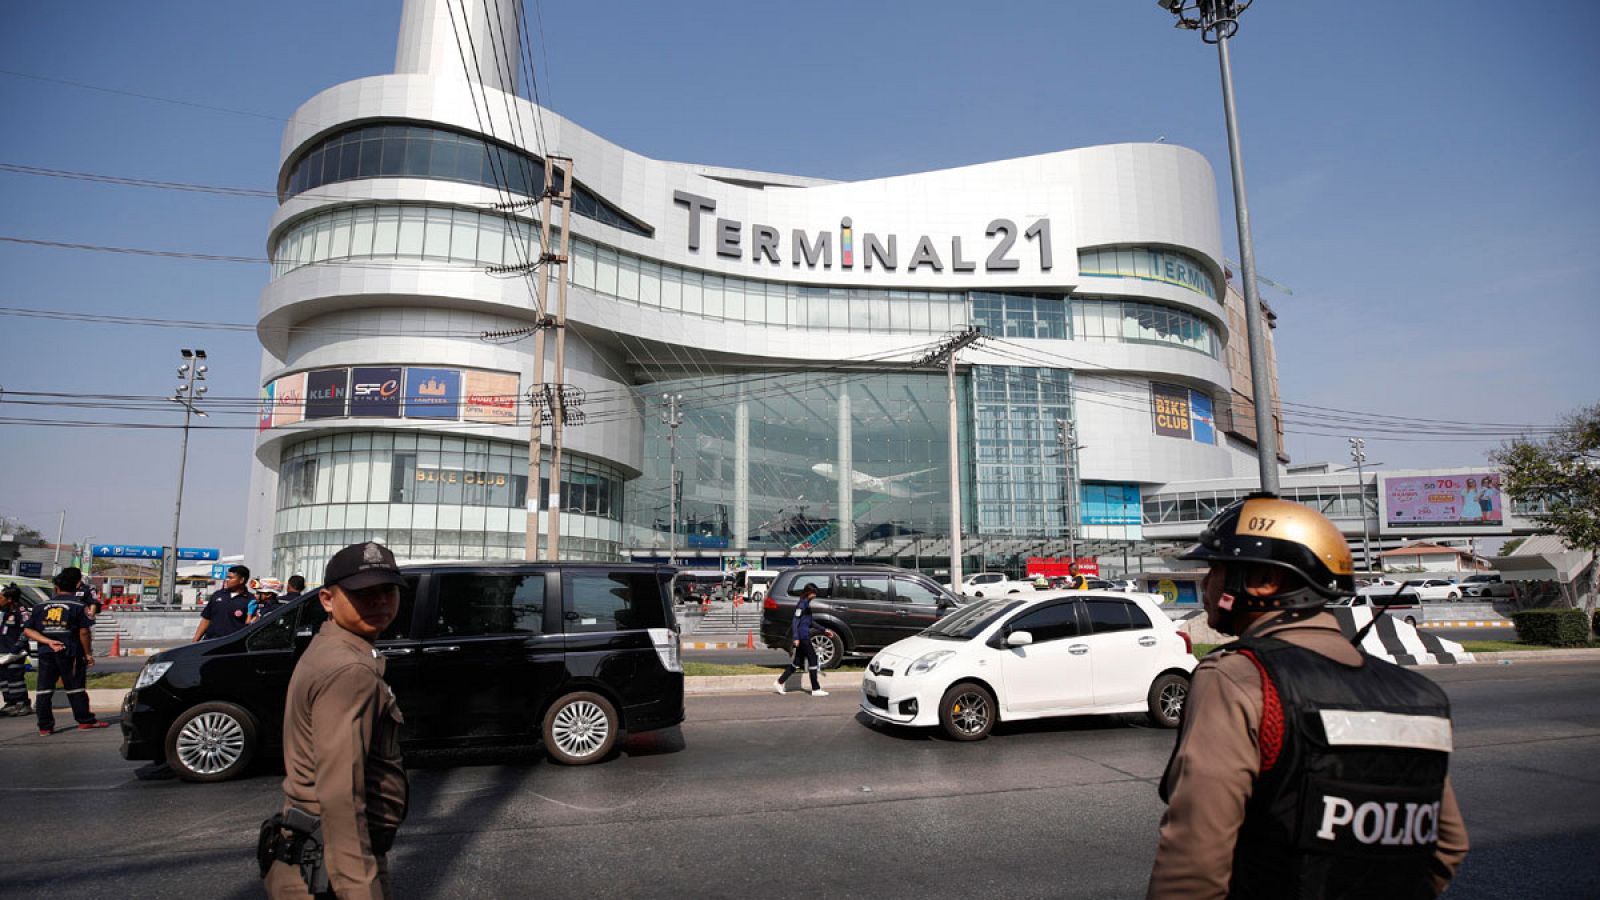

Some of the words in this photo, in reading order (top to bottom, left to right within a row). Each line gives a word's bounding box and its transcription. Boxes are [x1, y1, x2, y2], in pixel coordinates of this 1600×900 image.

[673, 189, 977, 271] TERMINAL
[985, 218, 1053, 271] 21
[310, 384, 345, 400] KLEIN
[1155, 398, 1188, 417] BIKE
[1157, 414, 1189, 430] CLUB
[416, 469, 457, 484] BIKE
[464, 472, 505, 485] CLUB
[1248, 516, 1276, 531] 037
